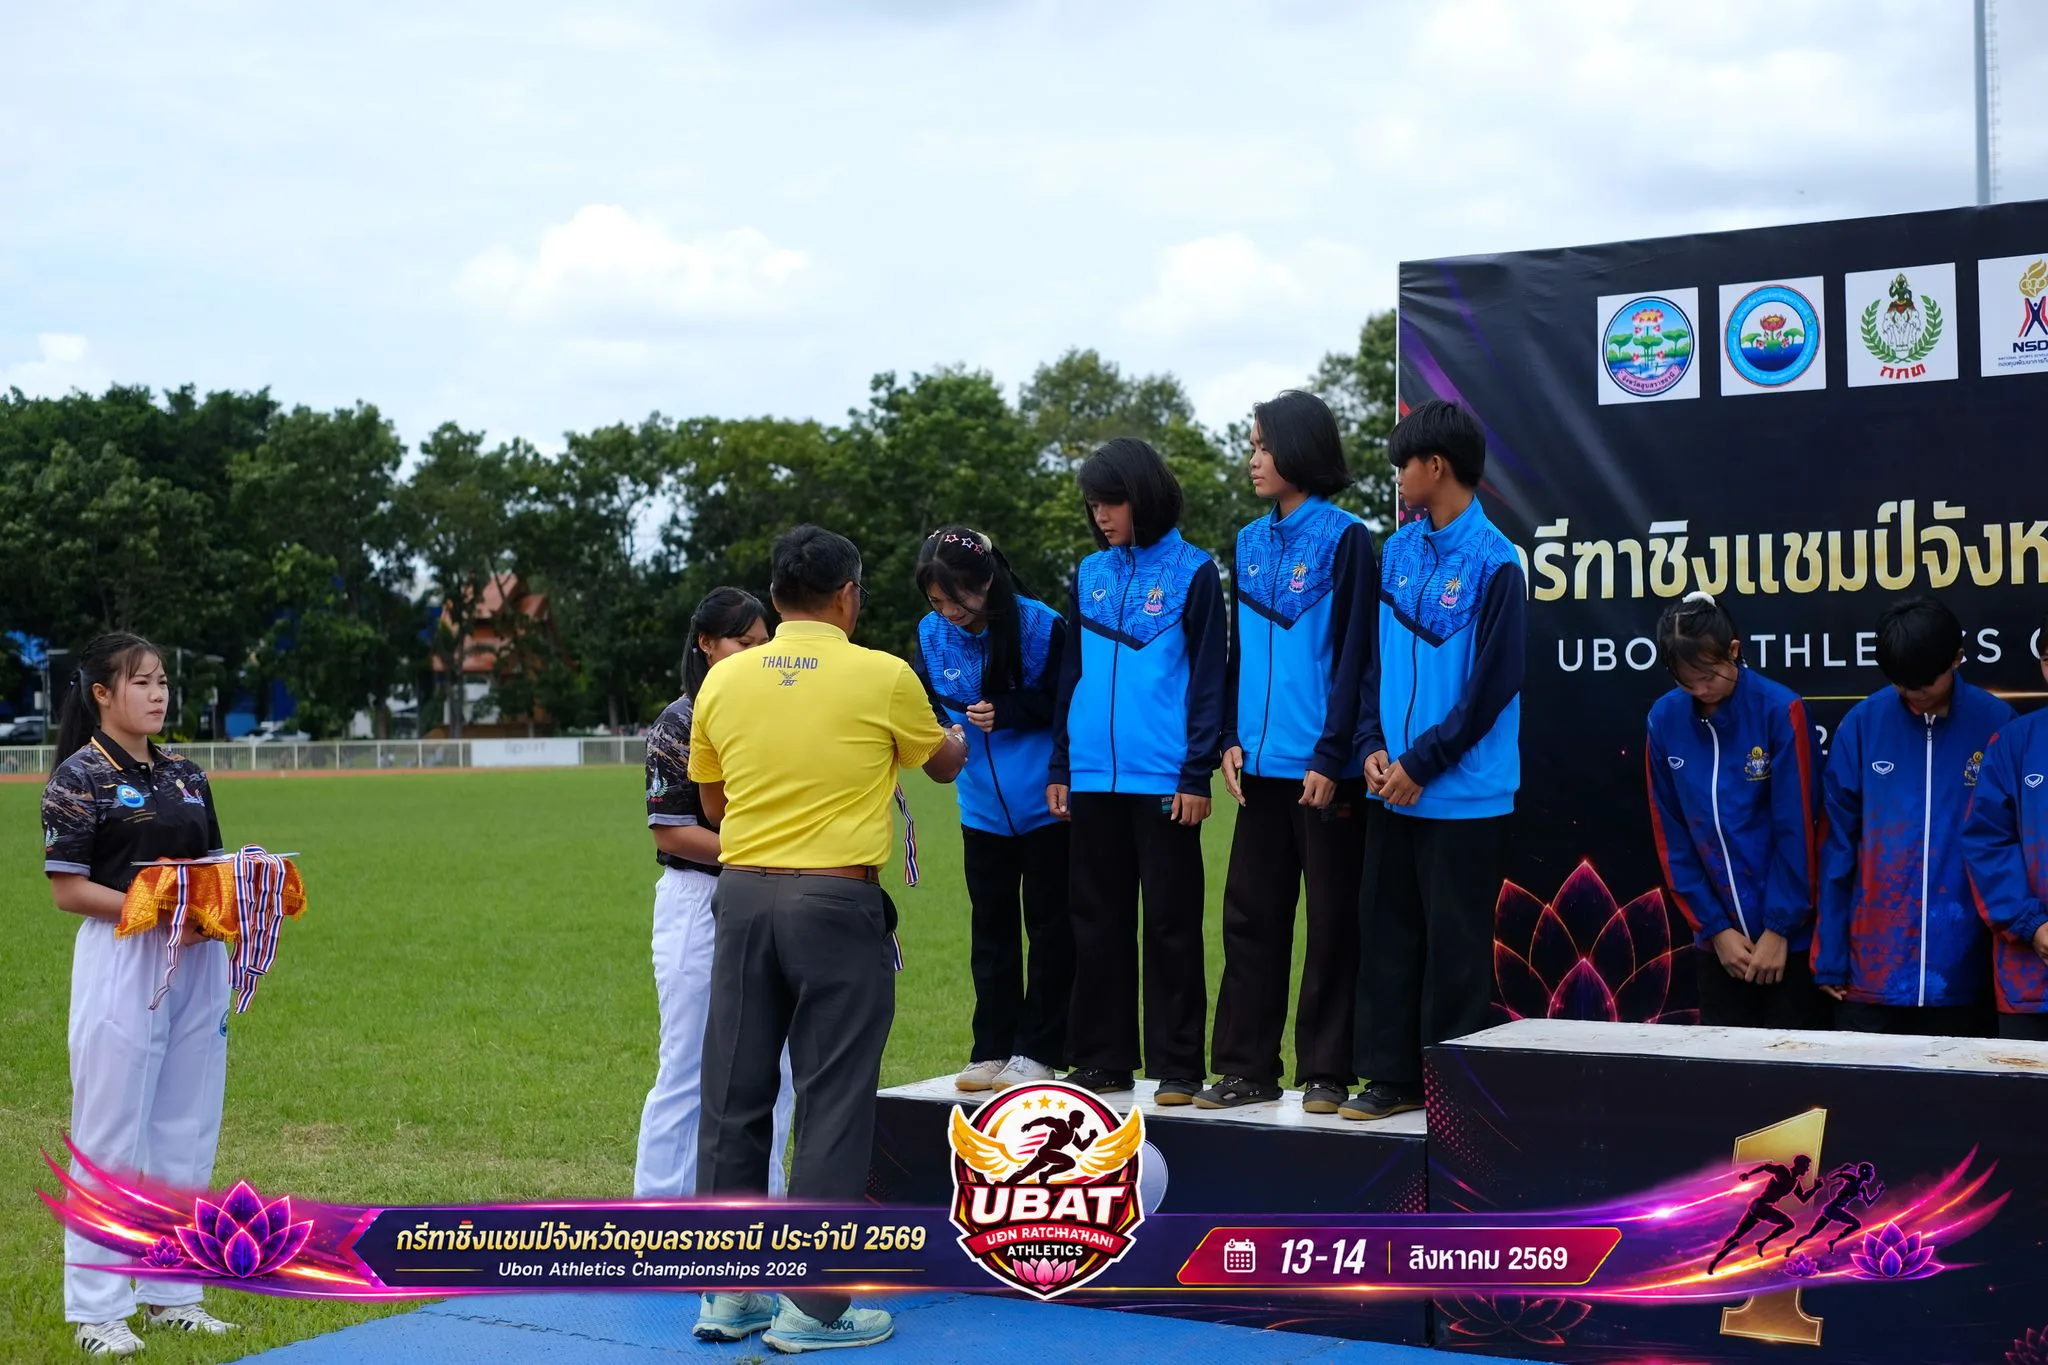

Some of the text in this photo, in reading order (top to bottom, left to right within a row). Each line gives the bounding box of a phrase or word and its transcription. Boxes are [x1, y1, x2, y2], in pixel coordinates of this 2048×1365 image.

[1880, 363, 1926, 380] กกท
[762, 655, 819, 670] THAILAND
[1558, 637, 1657, 672] UBO
